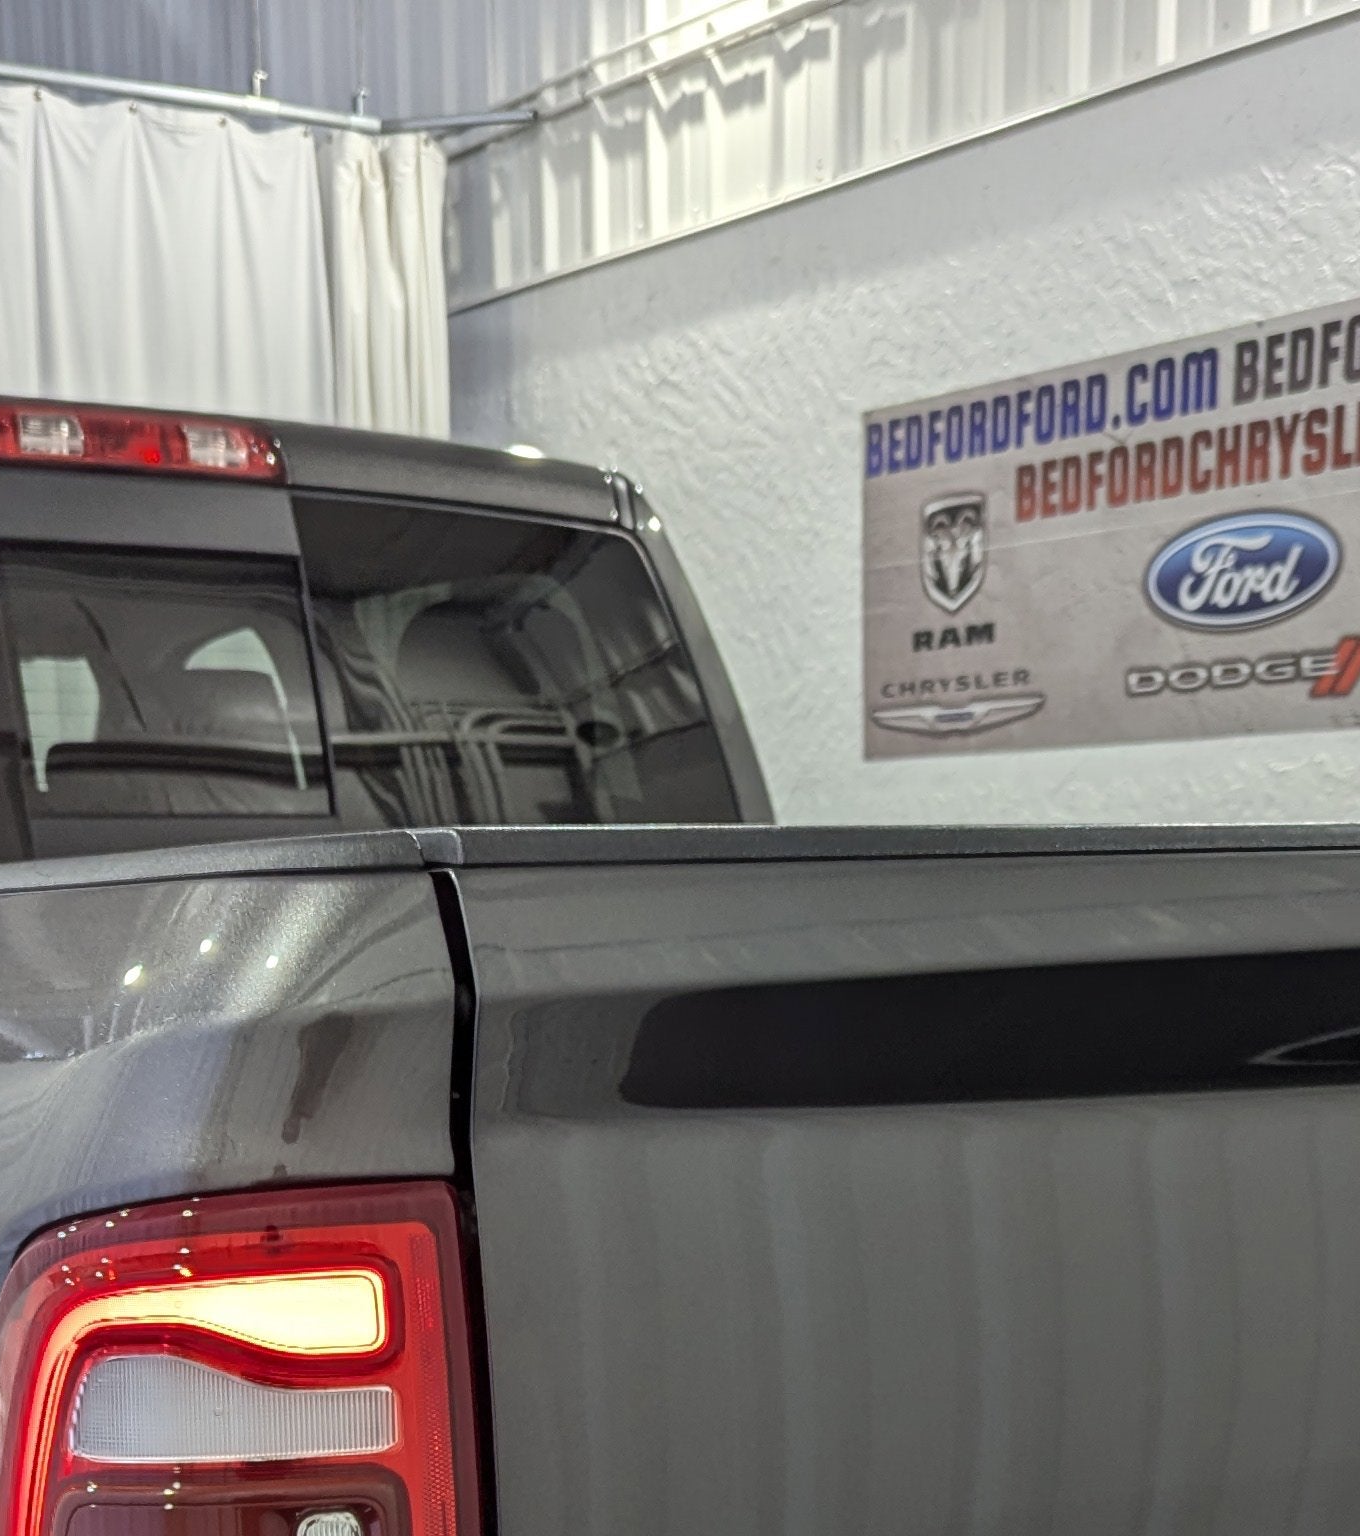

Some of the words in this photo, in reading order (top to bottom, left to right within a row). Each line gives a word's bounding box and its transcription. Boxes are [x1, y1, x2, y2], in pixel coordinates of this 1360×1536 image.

[866, 347, 1220, 479] BEDFORDFORD.COM
[1180, 531, 1300, 610] Ford
[912, 621, 995, 652] RAM
[882, 669, 1031, 698] CHRYSLER
[1126, 652, 1340, 697] DODGE
